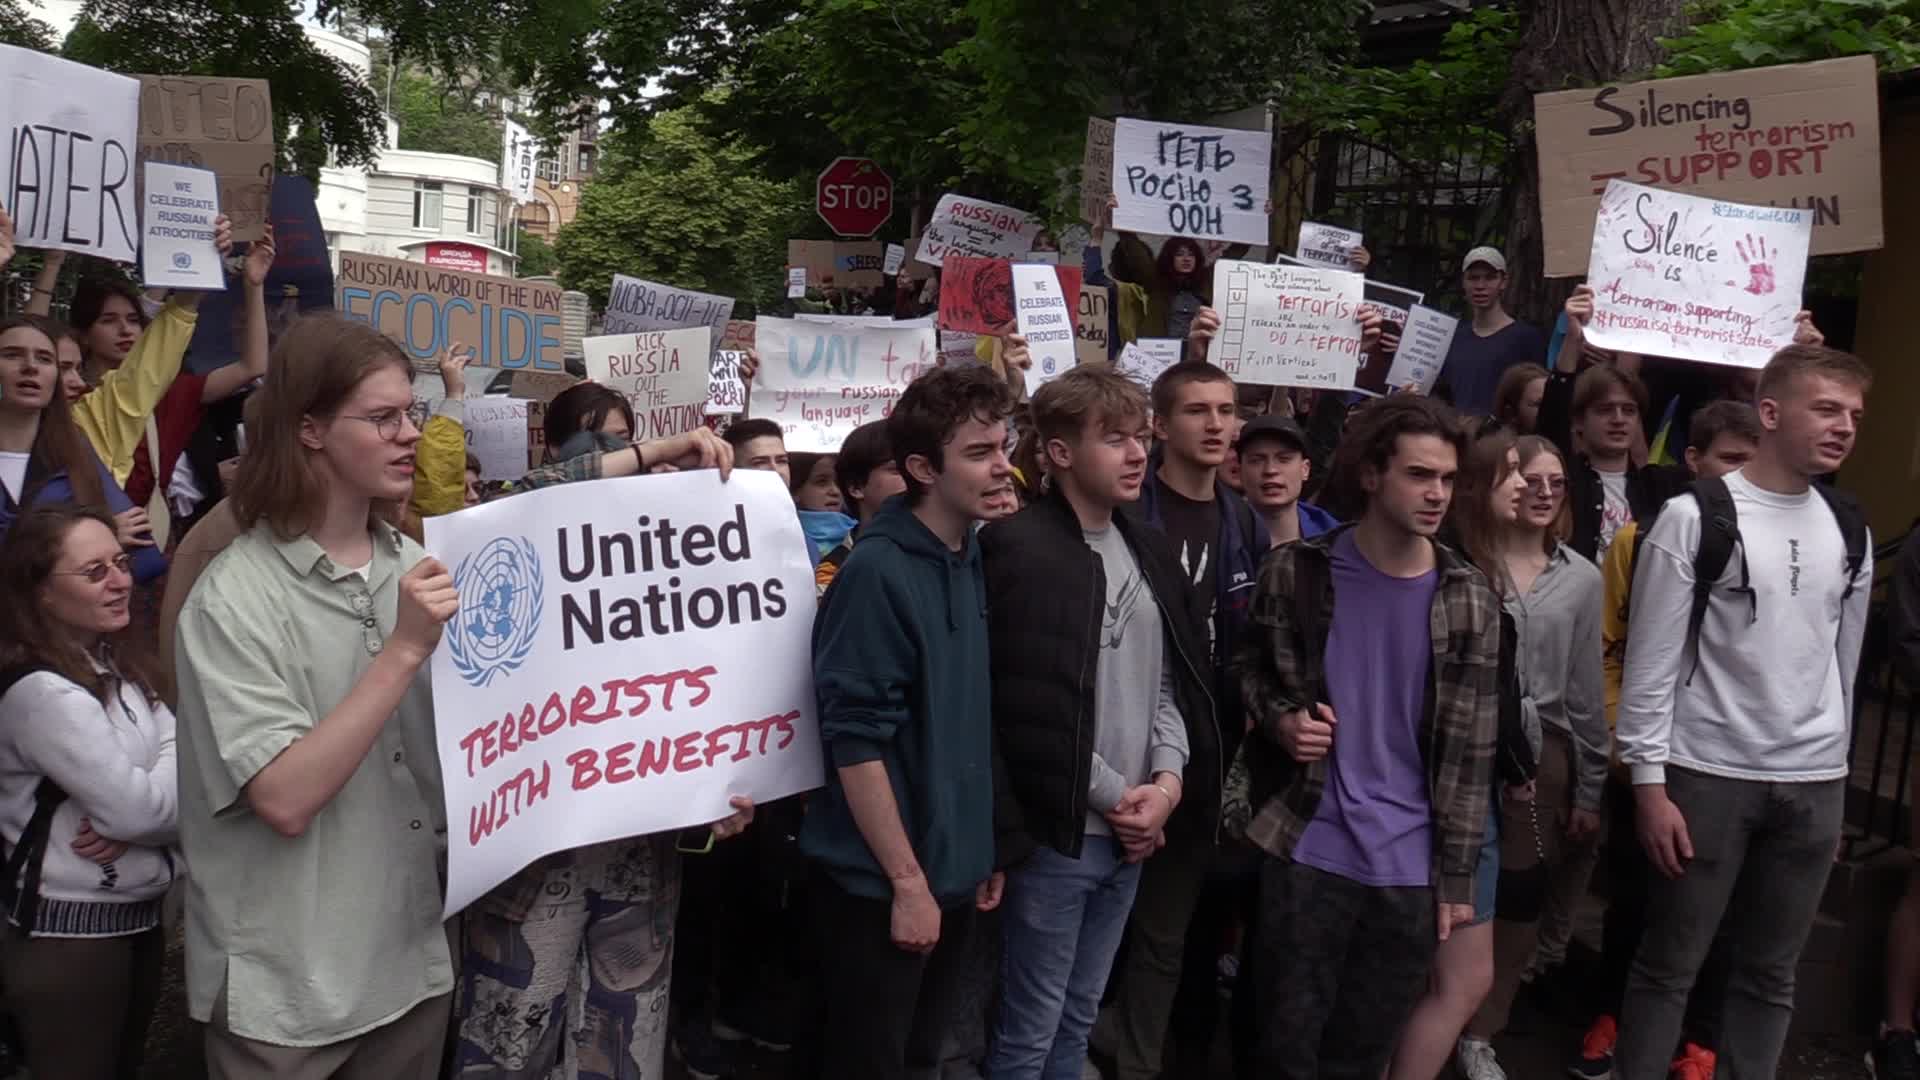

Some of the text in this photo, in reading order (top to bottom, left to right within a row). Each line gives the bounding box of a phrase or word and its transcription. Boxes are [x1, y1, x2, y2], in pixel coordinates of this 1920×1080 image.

[1589, 86, 1750, 136] Silencing
[1696, 119, 1855, 151] terrorism
[1158, 130, 1235, 172] ГЕТЬ
[1638, 144, 1828, 185] SUPPORT
[174, 182, 192, 193] WE
[823, 184, 888, 209] STOP
[150, 194, 215, 211] CELEBRATE
[158, 211, 208, 225] RUSSIAN
[1169, 203, 1223, 235] ООН
[1623, 192, 1718, 263] Silence
[149, 226, 216, 241] ATROCITIES
[341, 258, 562, 312] RUSSIAN WORD OF THE DAY
[1034, 281, 1047, 292] WE
[1664, 265, 1682, 282] is
[1020, 296, 1064, 310] CELEBRATE
[1028, 314, 1063, 326] RUSSIAN
[635, 332, 667, 352] KICK
[608, 348, 680, 378] RUSSIA
[787, 335, 860, 382] UN
[634, 375, 659, 393] OUT
[841, 385, 901, 399] russian
[649, 389, 669, 407] THE
[650, 400, 708, 438] NATIONS
[801, 402, 871, 427] language
[557, 504, 751, 583] United
[561, 577, 787, 650] Nations
[460, 665, 718, 778] TERRORISTS
[468, 710, 801, 848] WITH BENEFITS
